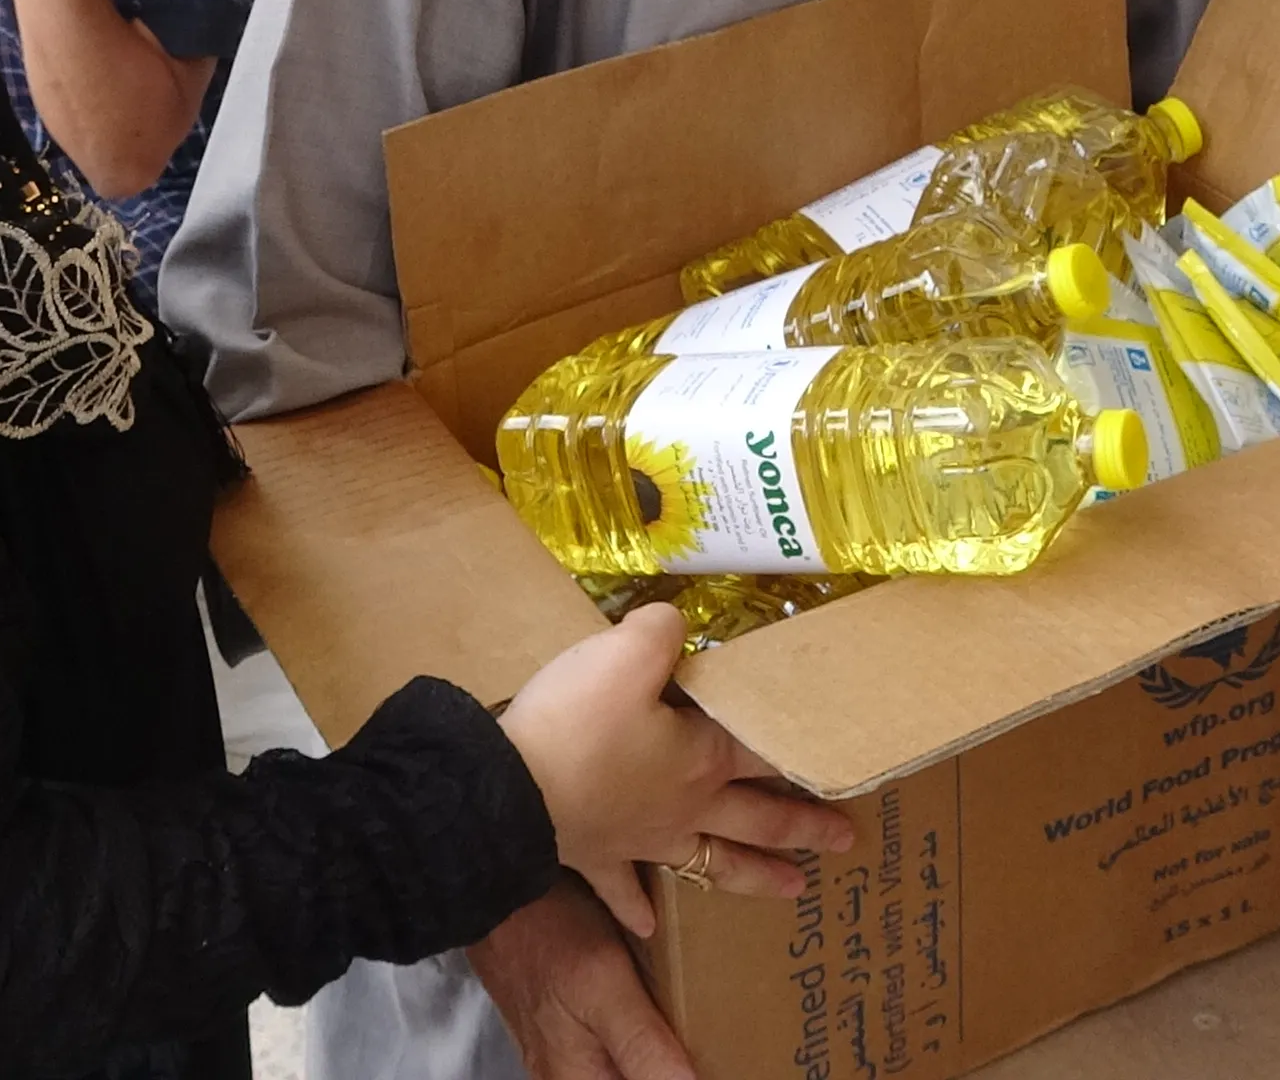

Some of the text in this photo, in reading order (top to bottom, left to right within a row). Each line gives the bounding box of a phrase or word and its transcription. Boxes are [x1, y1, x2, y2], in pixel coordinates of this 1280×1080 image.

[746, 430, 803, 559] yonca
[1163, 691, 1275, 747] wfp.org
[877, 788, 902, 896] Vitamin
[1044, 790, 1132, 842] World
[1142, 757, 1211, 802] Food
[920, 831, 951, 890] مدعم
[1154, 858, 1188, 881] Not
[1195, 844, 1226, 865] for
[880, 900, 903, 957] with
[912, 900, 947, 990] بفيتامين
[834, 866, 876, 1080] زيت دوار الشمس
[790, 963, 831, 1080] efined
